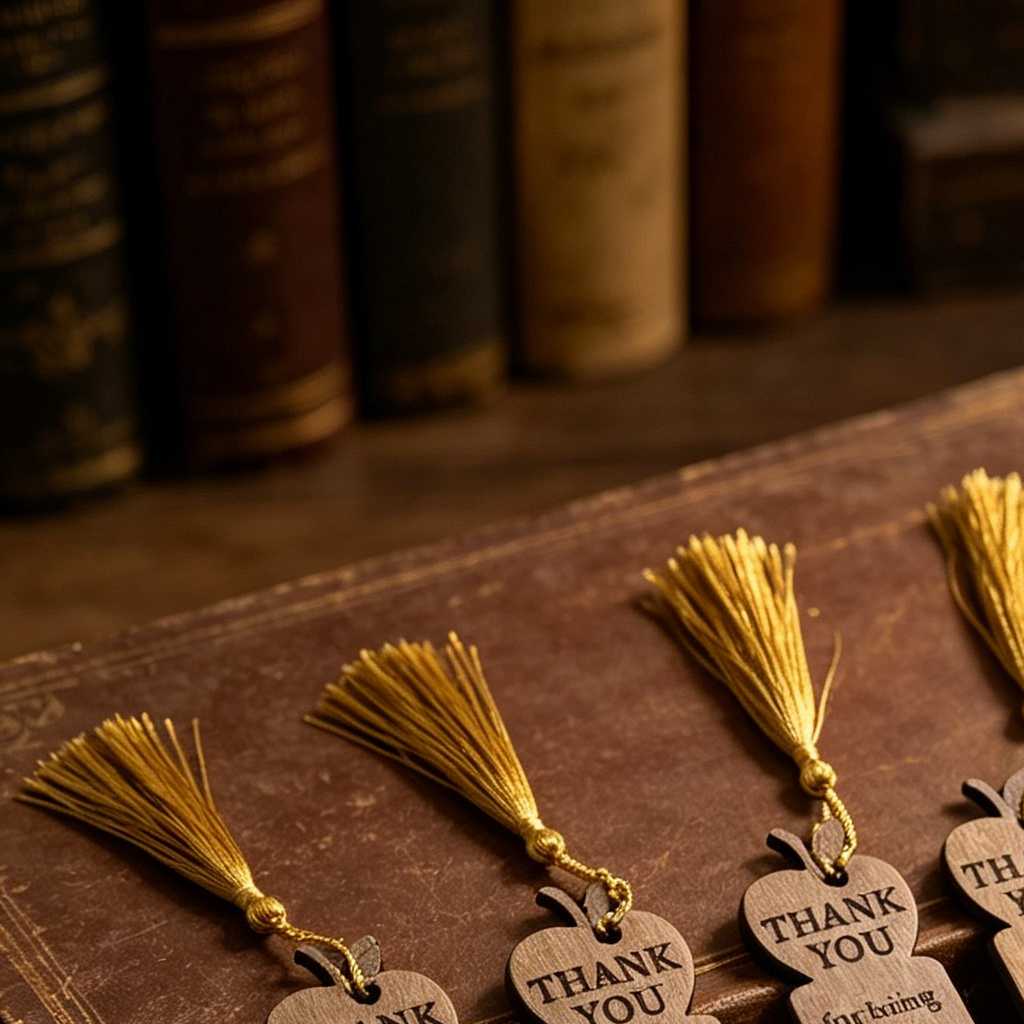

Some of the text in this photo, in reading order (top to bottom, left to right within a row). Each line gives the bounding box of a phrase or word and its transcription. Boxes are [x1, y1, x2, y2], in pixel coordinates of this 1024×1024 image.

[761, 886, 907, 944] THANK
[527, 942, 682, 1004] THANK
[806, 926, 895, 971] YOU
